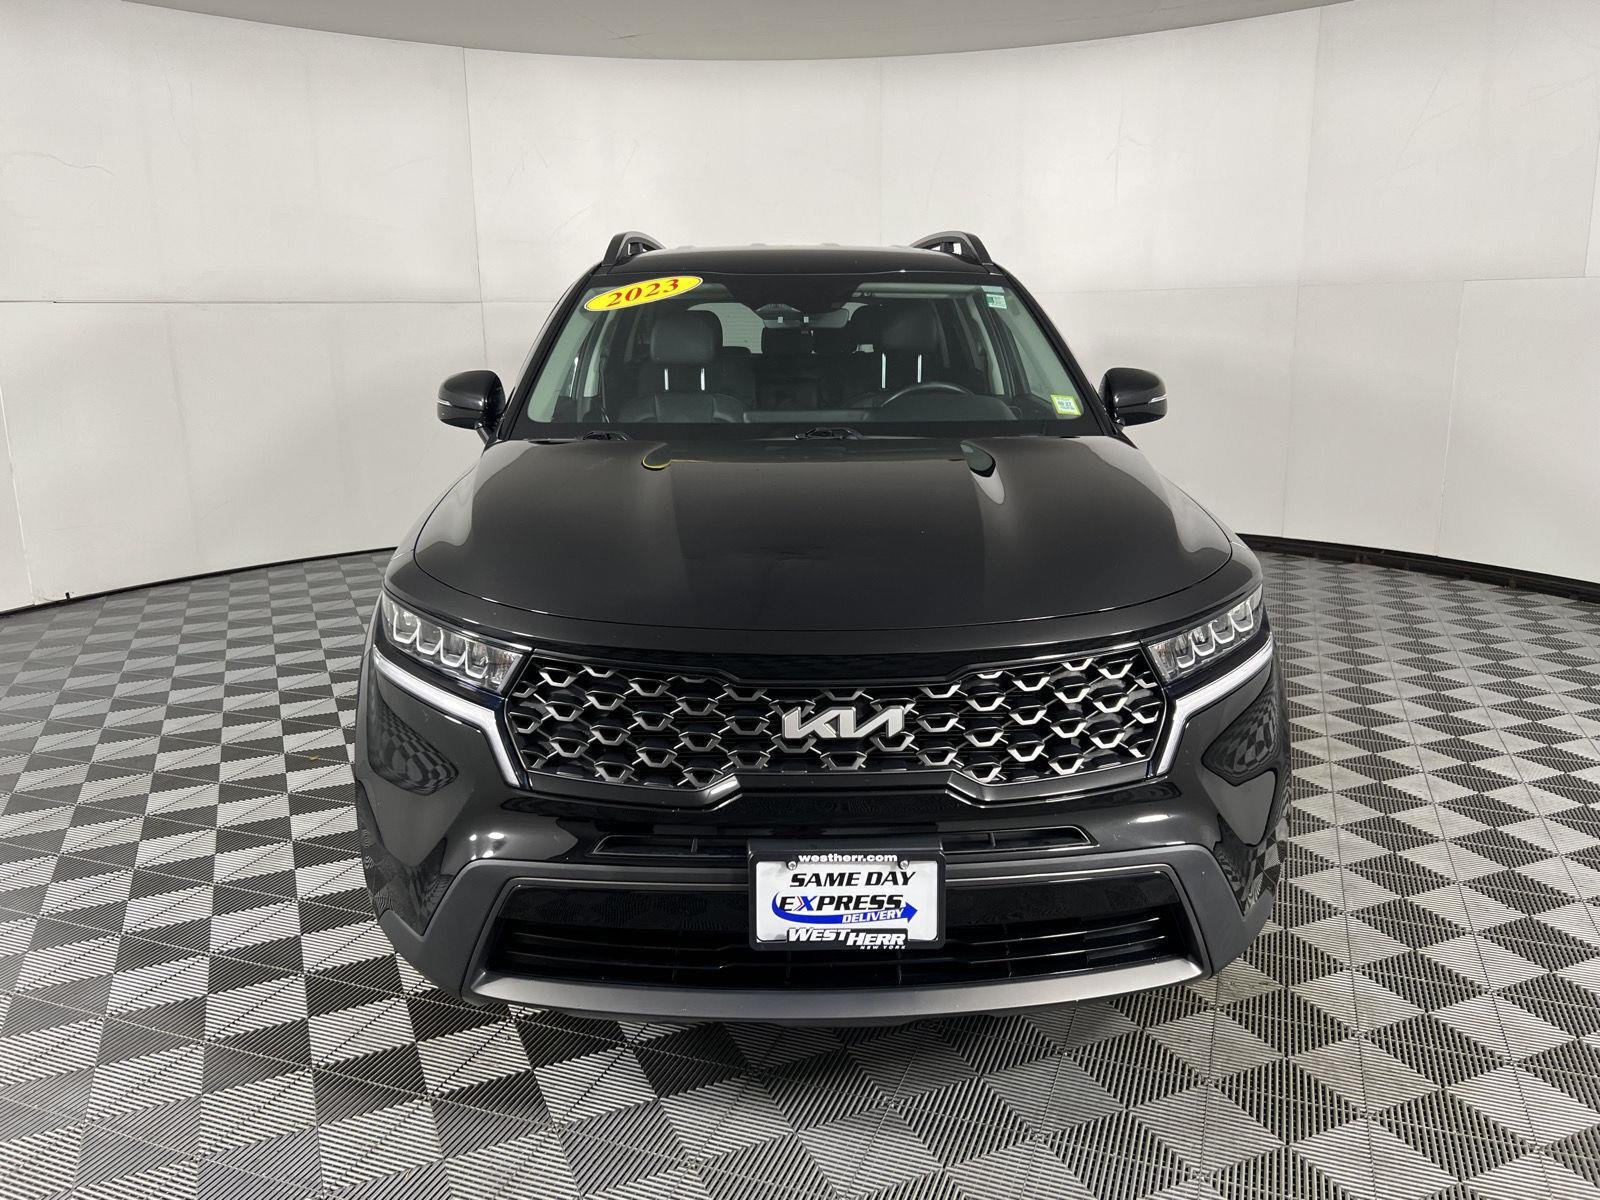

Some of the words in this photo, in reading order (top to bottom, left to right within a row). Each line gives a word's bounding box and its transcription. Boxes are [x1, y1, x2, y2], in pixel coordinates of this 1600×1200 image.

[605, 278, 680, 308] 2023
[782, 705, 905, 738] KIA
[798, 853, 898, 863] westherr.com
[790, 871, 862, 887] SAME
[865, 871, 916, 887] DAY
[778, 894, 904, 912] EXPRESS
[841, 909, 905, 924] DELIVERY
